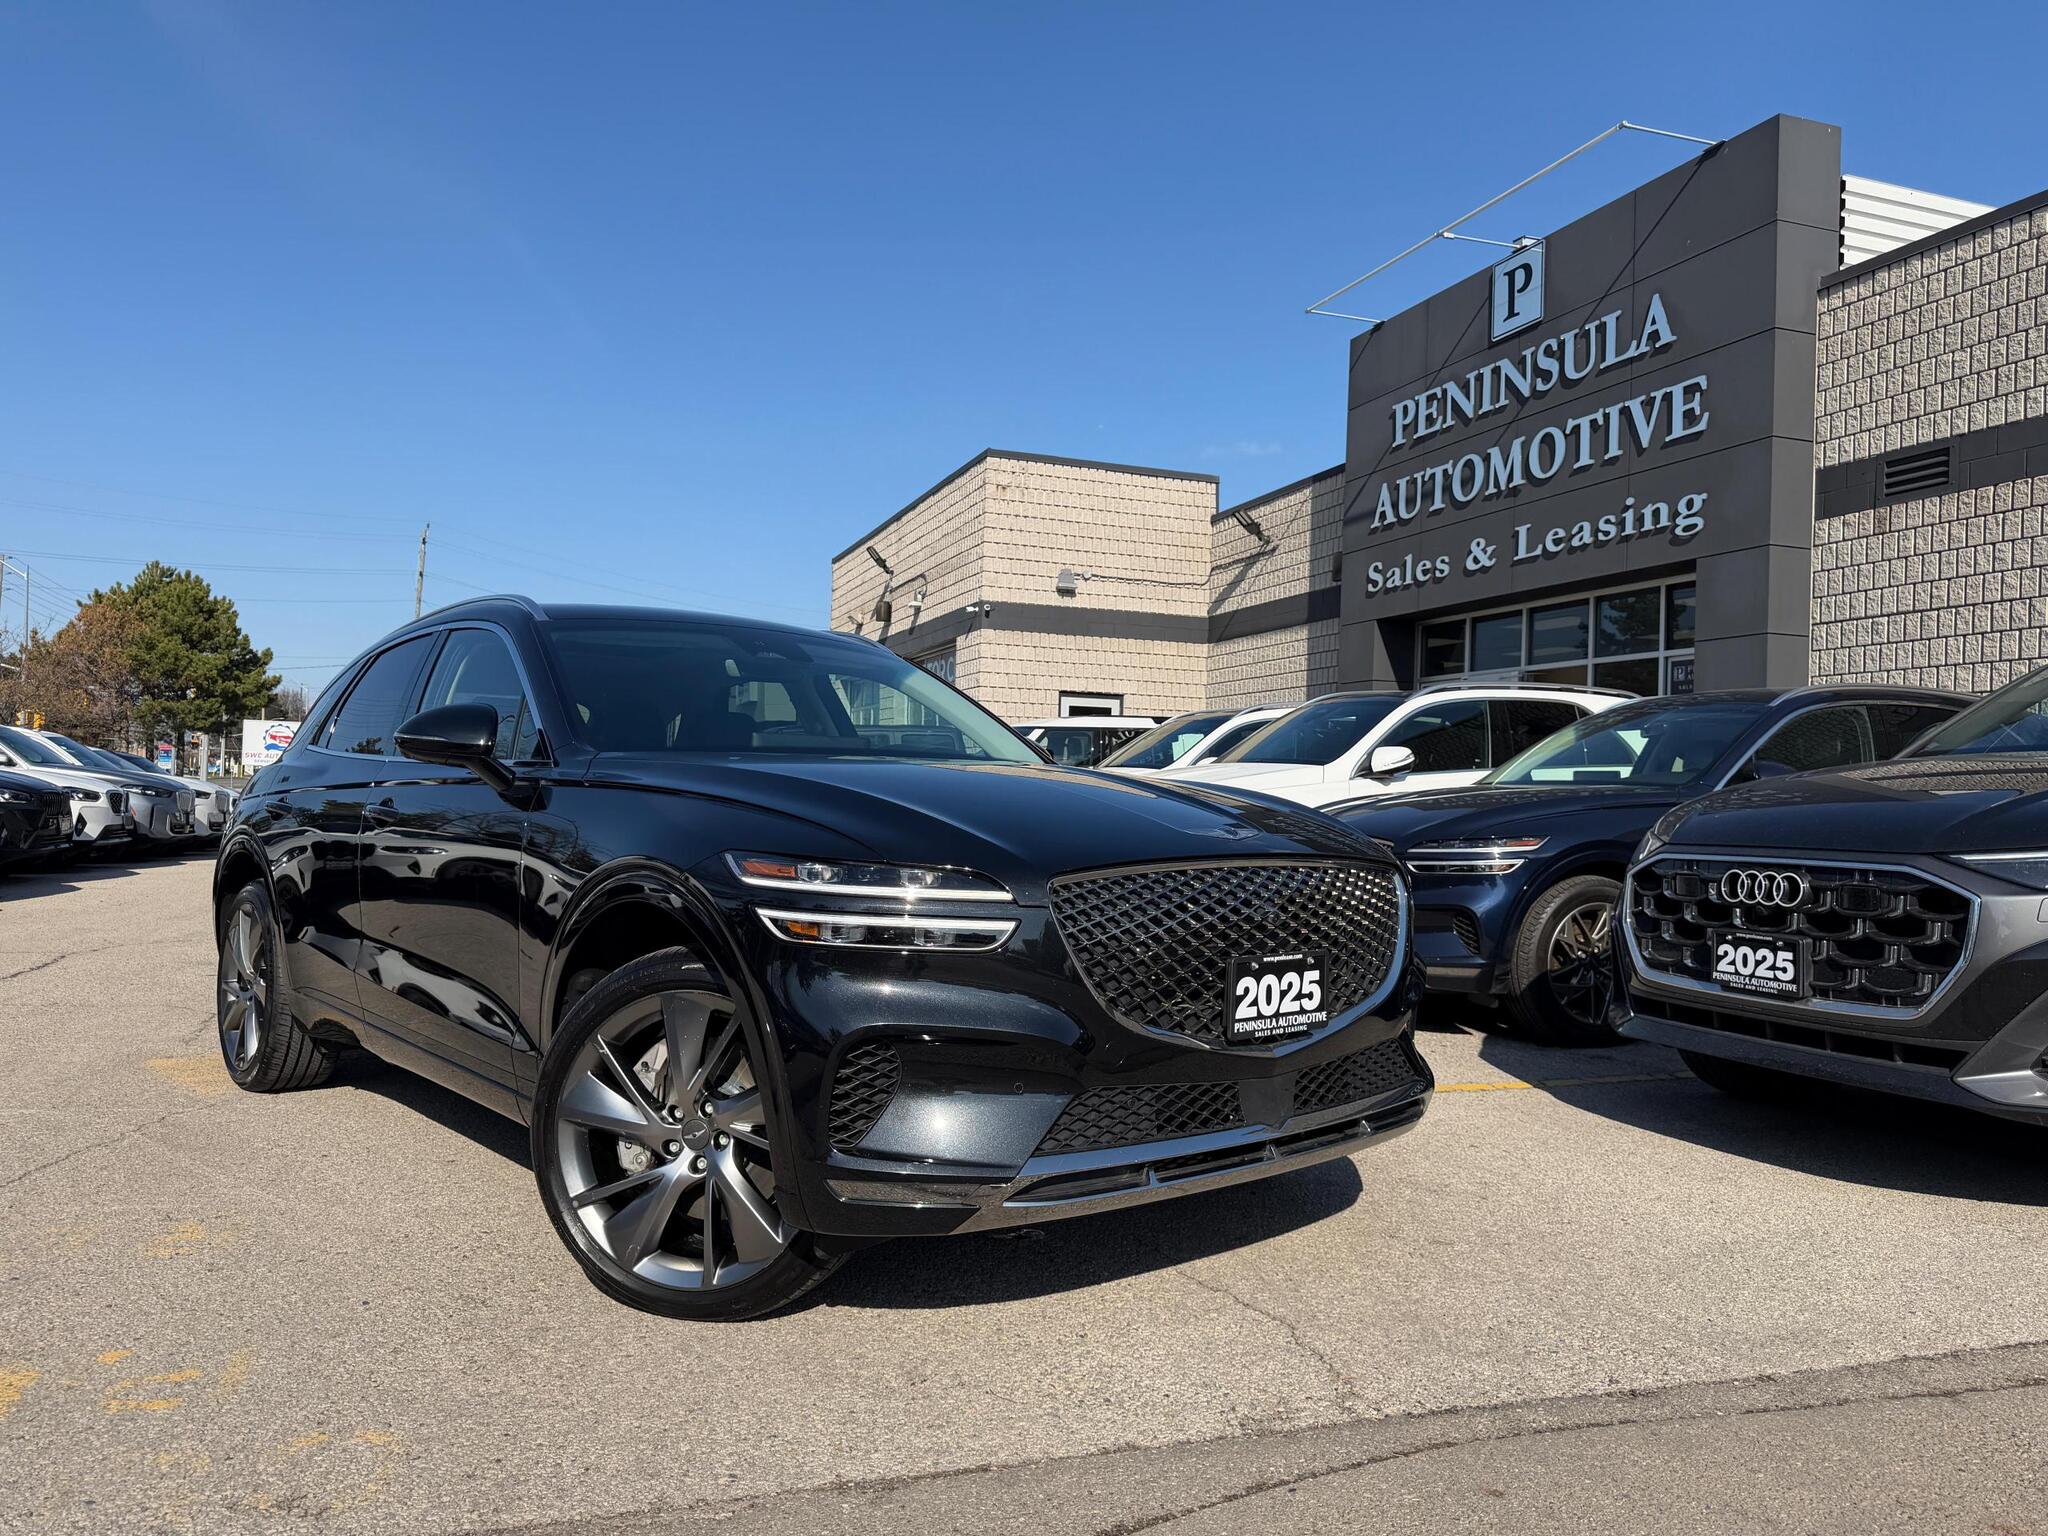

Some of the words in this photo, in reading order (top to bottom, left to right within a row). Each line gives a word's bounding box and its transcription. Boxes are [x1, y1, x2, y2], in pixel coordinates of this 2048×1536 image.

[1503, 262, 1533, 323] P
[1391, 293, 1678, 448] PENINSULA
[1370, 374, 1710, 529] AUTOMOTIVE
[1366, 553, 1451, 593] Sales
[1465, 537, 1497, 571] &
[1512, 492, 1708, 562] Leasing
[1712, 971, 1750, 985] PENINSULA
[1750, 977, 1798, 992] AUTOMOTIVE
[1716, 943, 1795, 982] 2025
[1235, 969, 1322, 1020] 2025
[1757, 985, 1778, 994] LEASING
[1234, 1017, 1277, 1033] PENINSULA
[1277, 1011, 1328, 1027] AUTOMOTIVE
[1255, 1028, 1271, 1038] SALES
[1272, 1027, 1284, 1035] AND
[1285, 1025, 1308, 1034] LEASING
